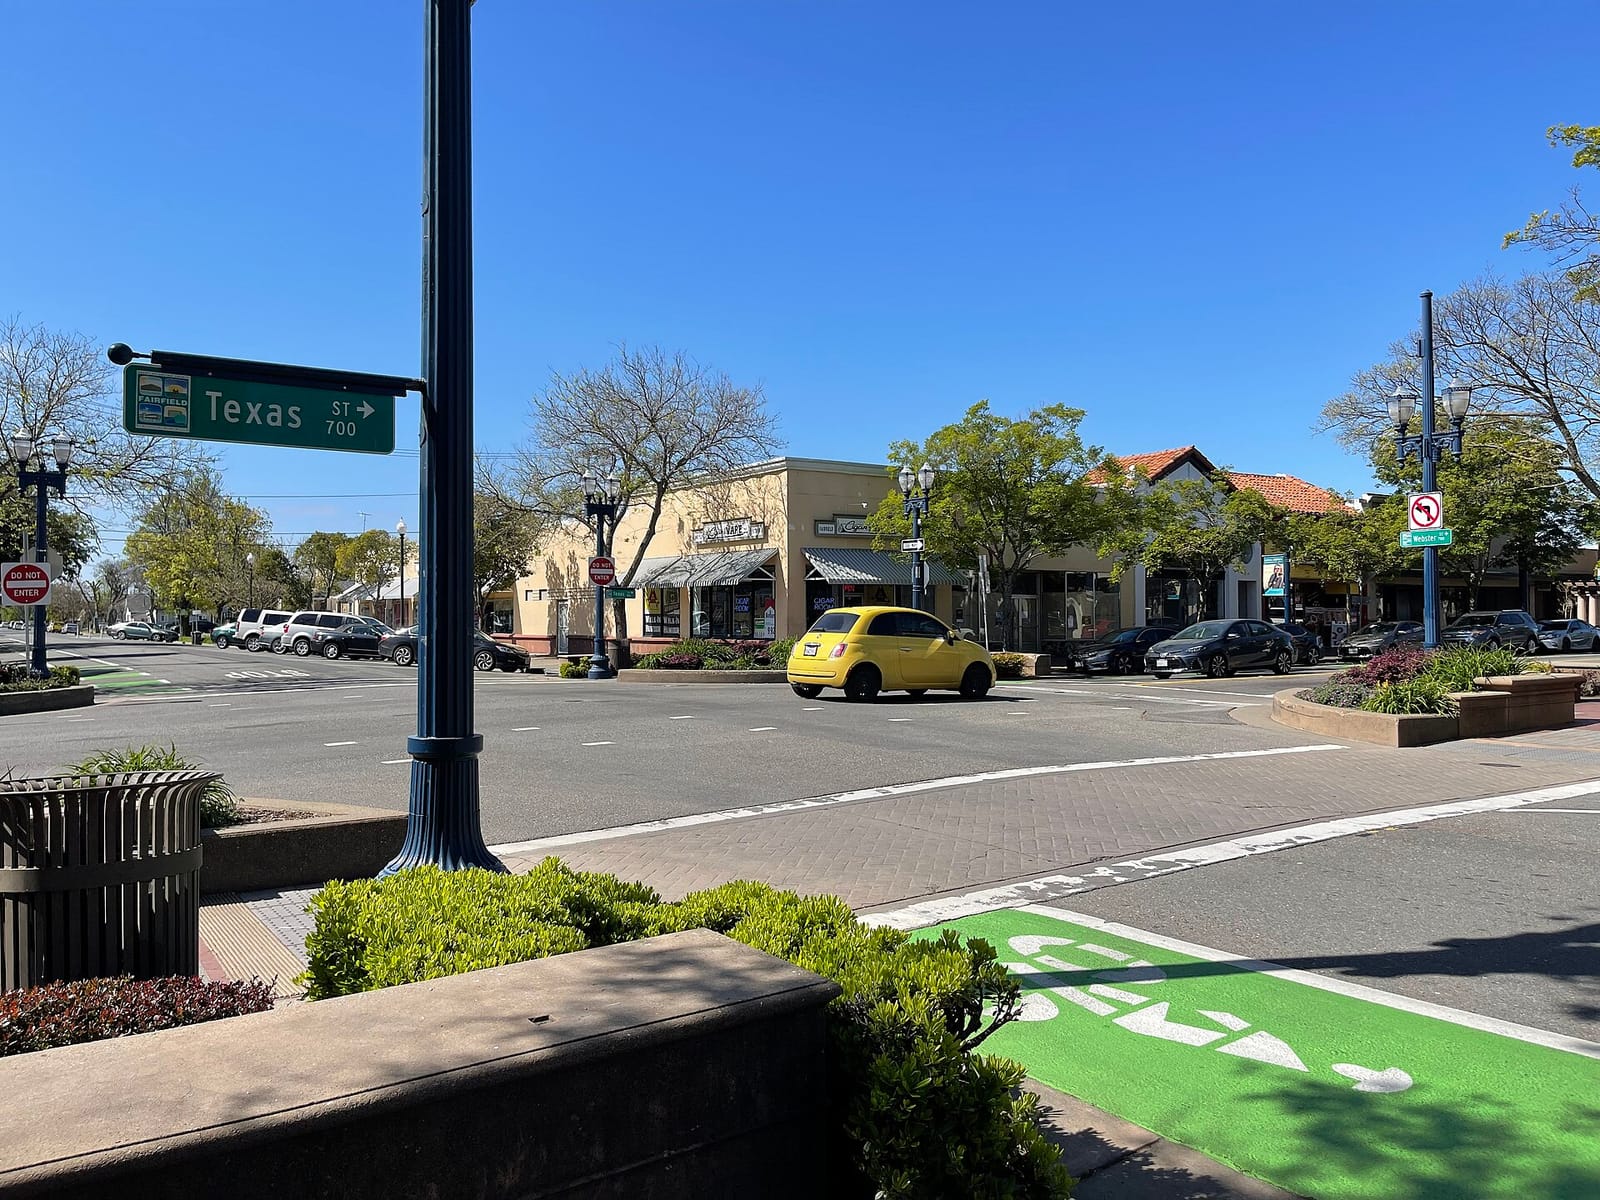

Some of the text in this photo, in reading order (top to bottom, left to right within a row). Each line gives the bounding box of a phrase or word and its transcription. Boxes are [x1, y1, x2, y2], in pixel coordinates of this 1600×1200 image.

[138, 395, 188, 406] FAIRFIELD
[205, 390, 350, 429] Texas ST
[325, 420, 356, 437] 700
[1412, 534, 1437, 543] Webster
[11, 571, 41, 580] DO NOT
[13, 588, 39, 597] ENTER
